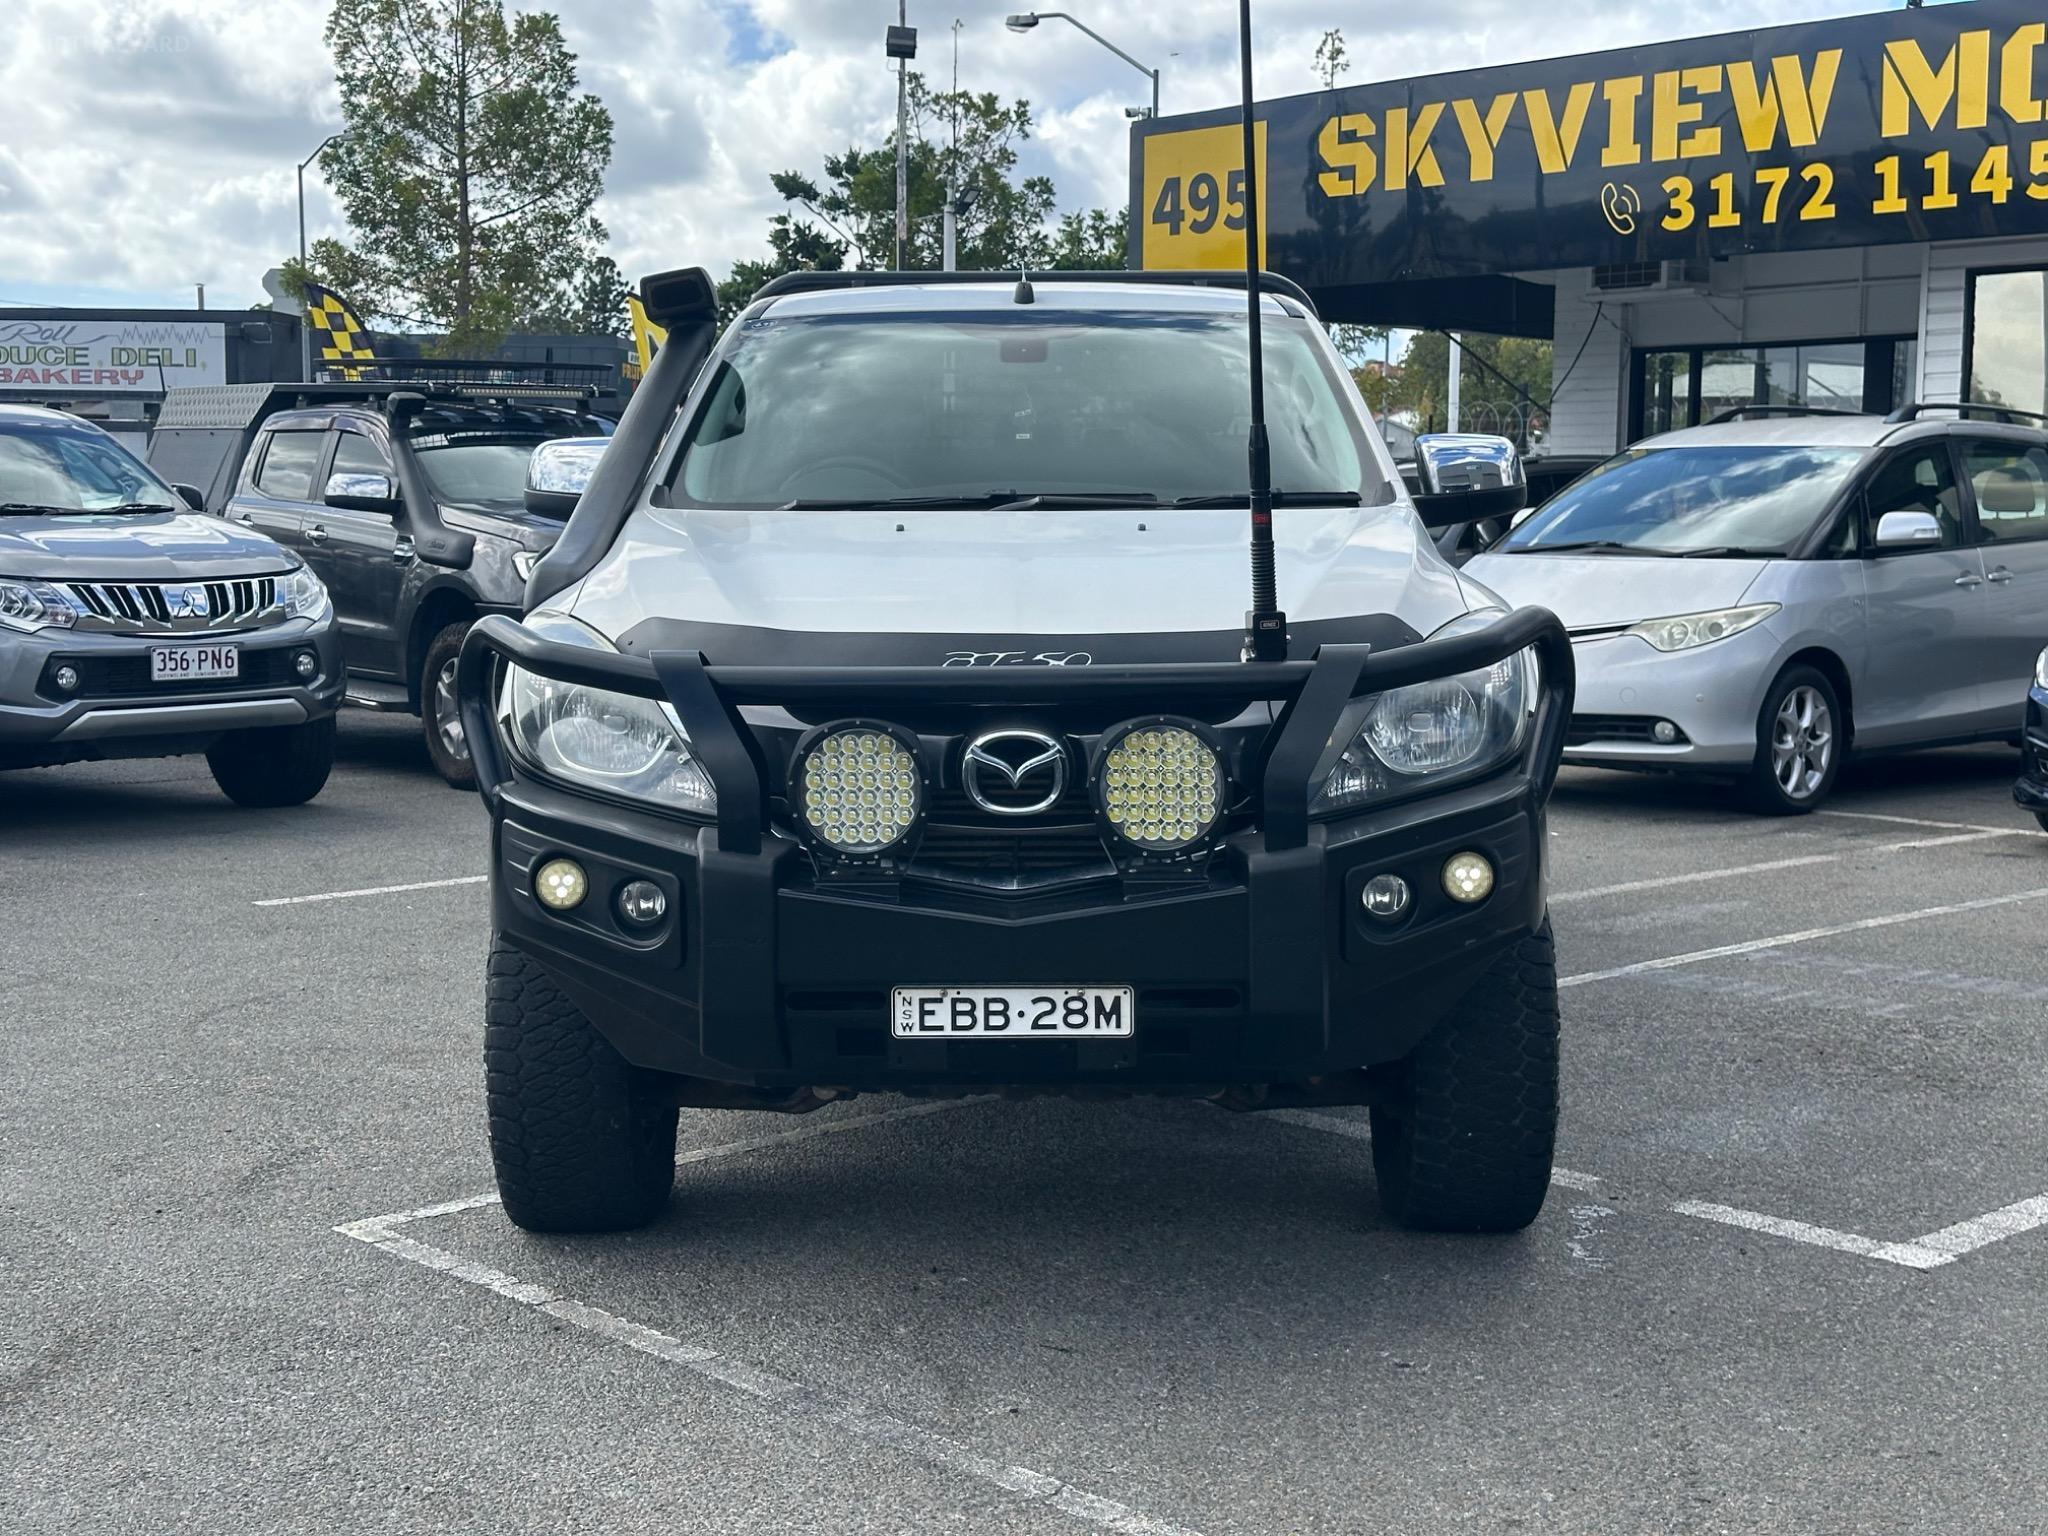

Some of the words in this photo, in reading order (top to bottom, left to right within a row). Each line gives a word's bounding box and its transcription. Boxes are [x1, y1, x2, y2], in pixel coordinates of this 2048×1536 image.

[1317, 48, 1843, 198] SKYVIEW
[1152, 169, 1248, 236] 495
[1660, 162, 1836, 232] 3172
[0, 322, 80, 345] Roll
